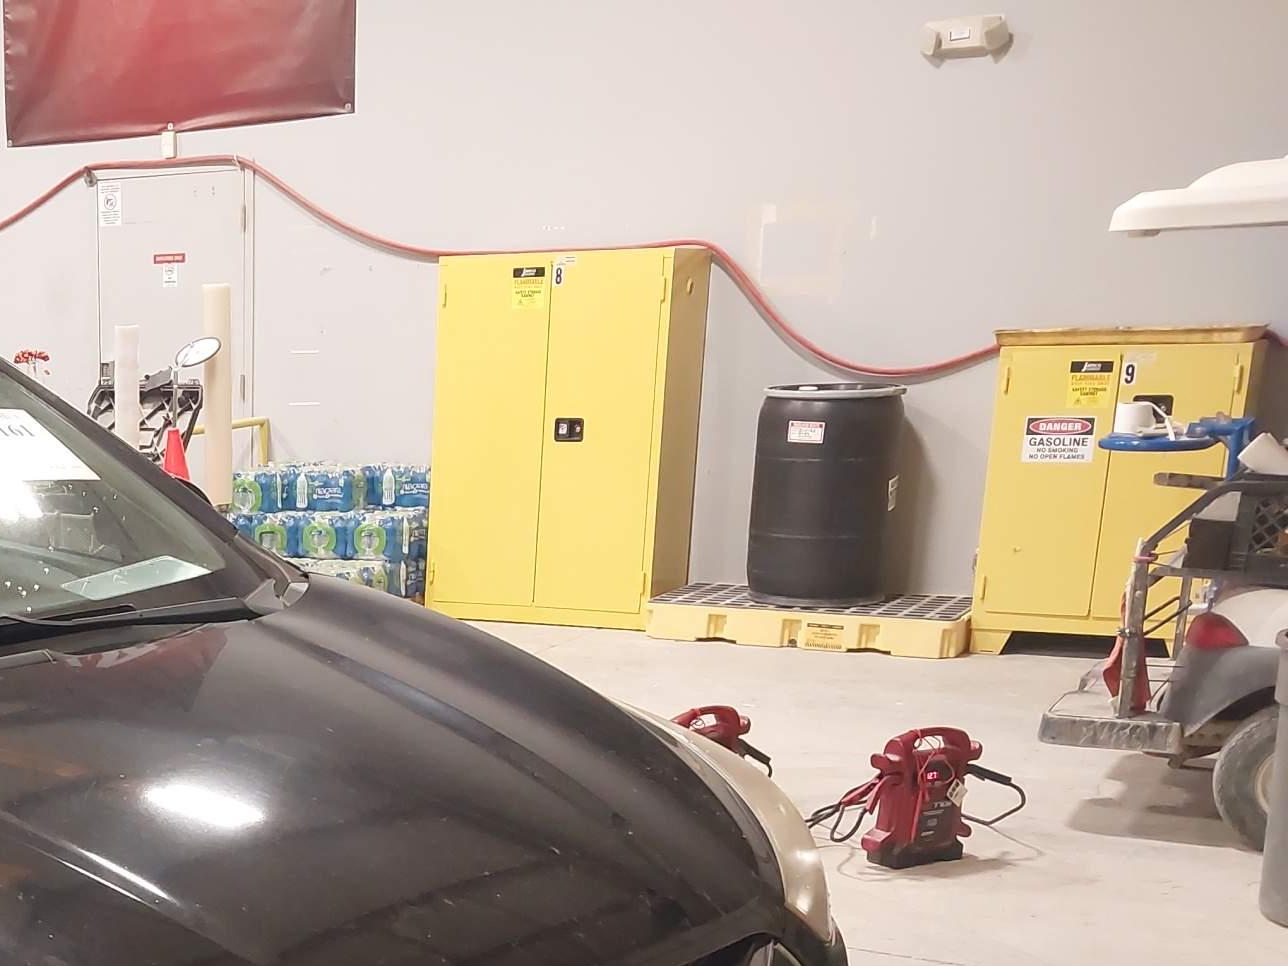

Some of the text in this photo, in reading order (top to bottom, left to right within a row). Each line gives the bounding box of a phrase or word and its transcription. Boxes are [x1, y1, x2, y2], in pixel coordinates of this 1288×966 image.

[555, 267, 562, 284] 8
[1124, 364, 1135, 384] 9
[1039, 422, 1082, 431] DANGER
[1028, 437, 1089, 447] GASOLINE
